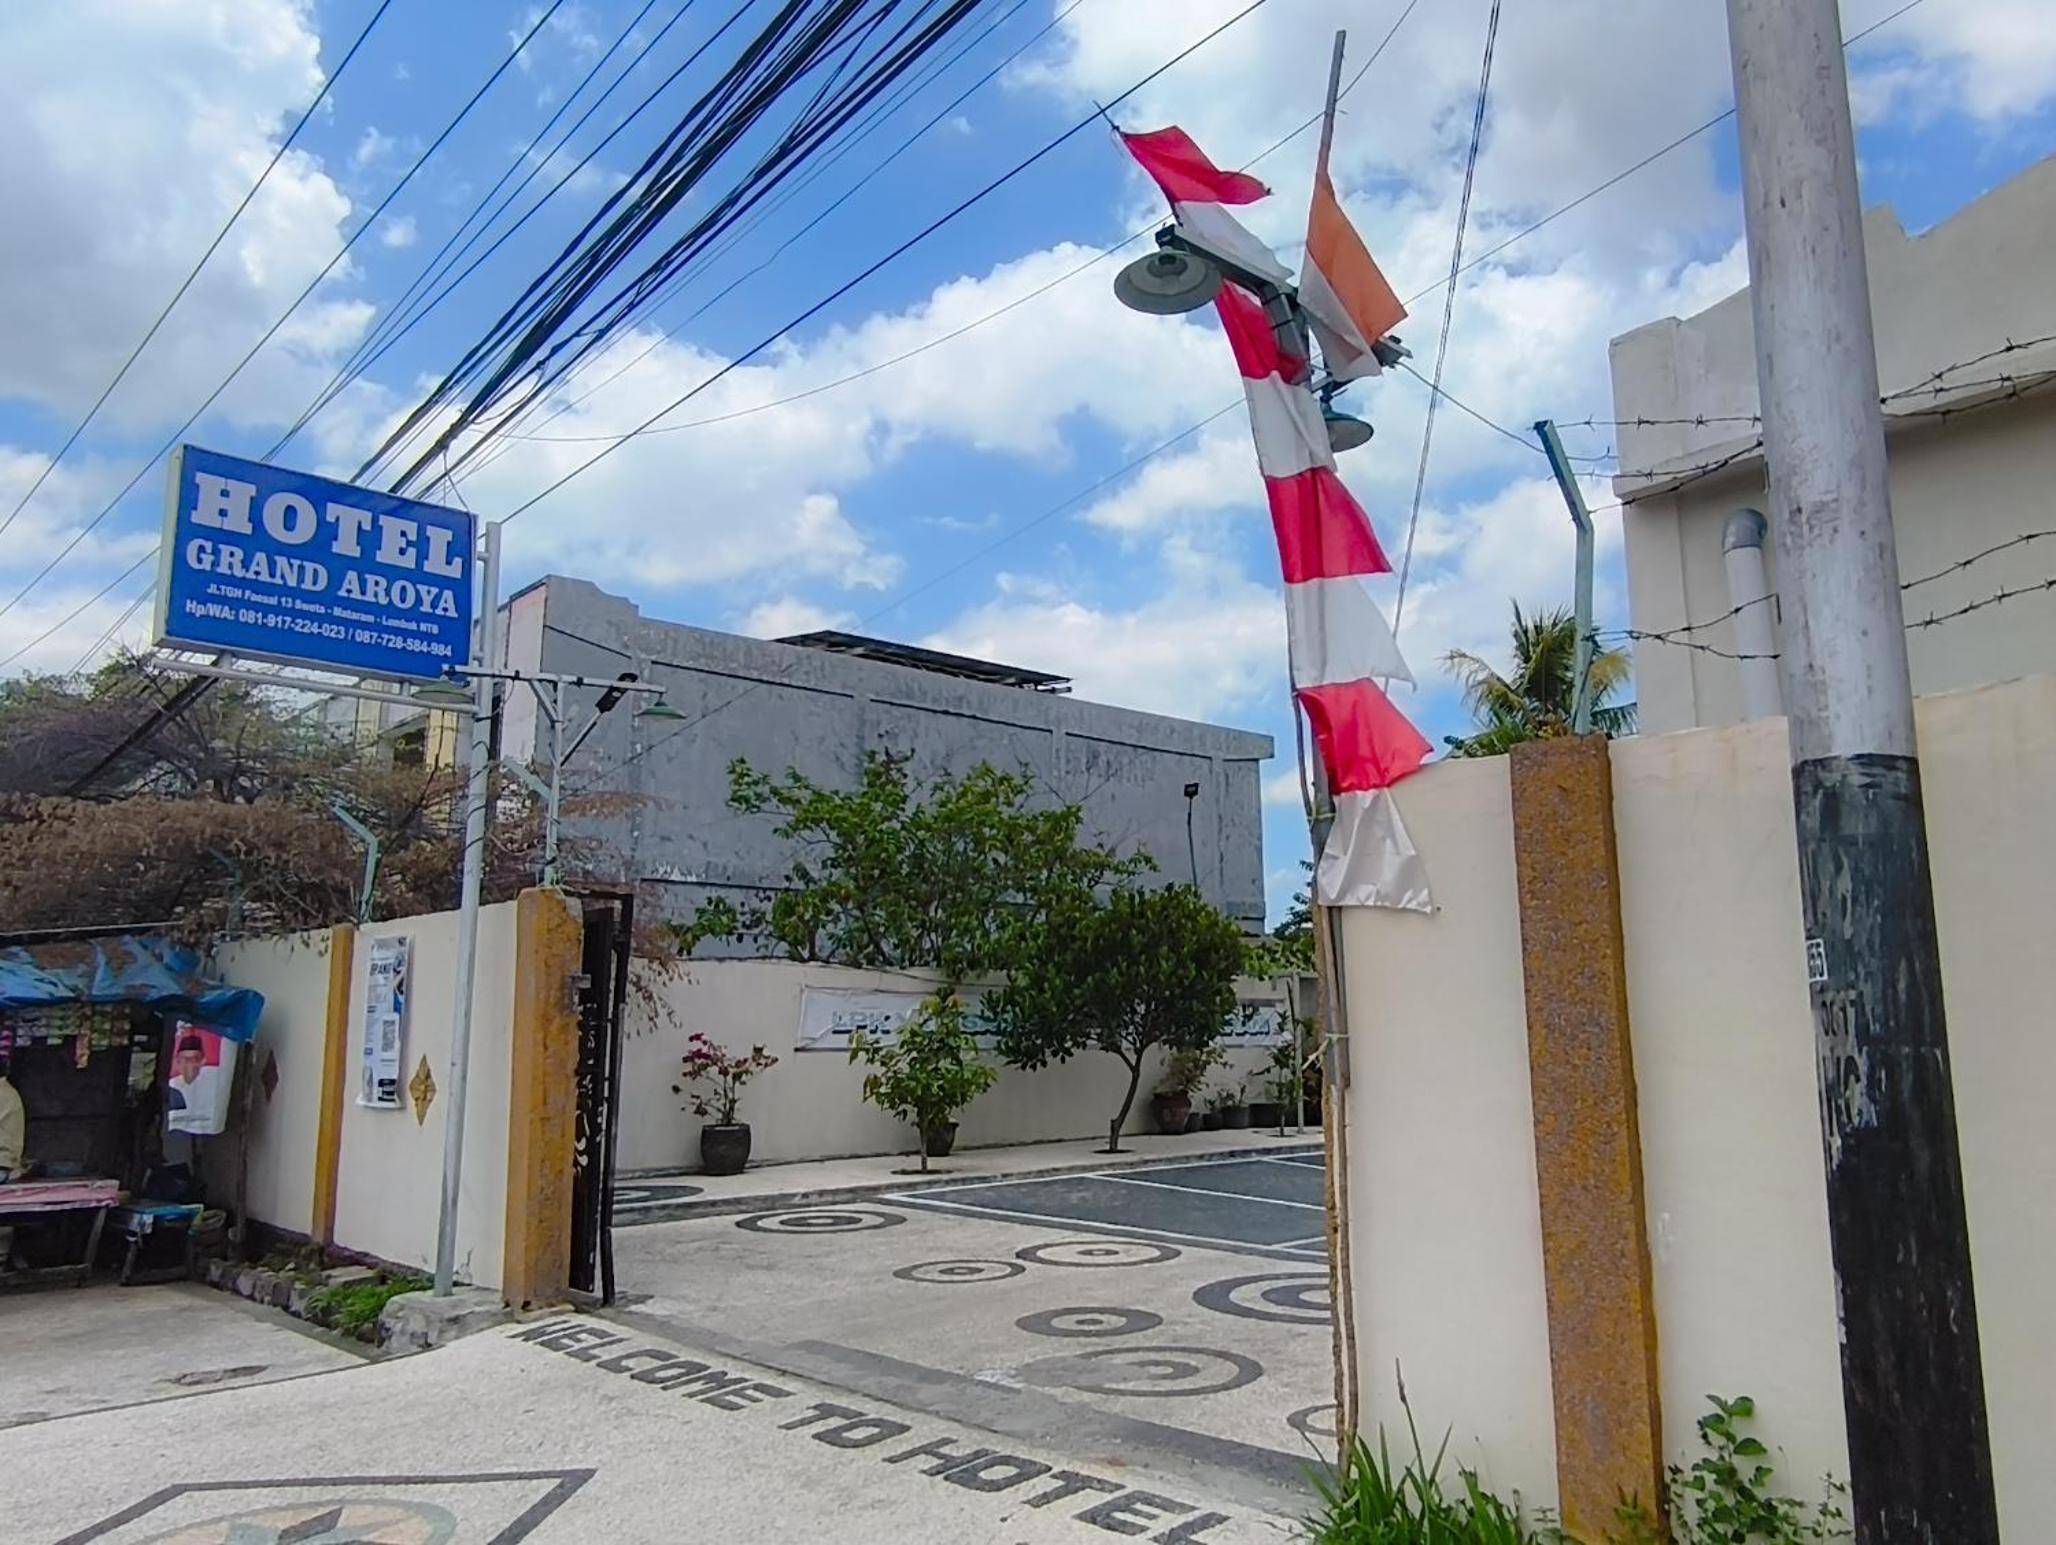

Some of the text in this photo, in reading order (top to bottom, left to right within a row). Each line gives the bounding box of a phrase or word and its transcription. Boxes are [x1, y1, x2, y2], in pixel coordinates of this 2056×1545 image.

[190, 471, 463, 579] HOTEL
[185, 538, 459, 618] GRAND AROYA
[185, 598, 236, 620] Hp/WA:
[238, 608, 346, 639] 081-917-224-023
[419, 623, 439, 634] NTB
[505, 1318, 1232, 1545] WELCOME TO HOTEL
